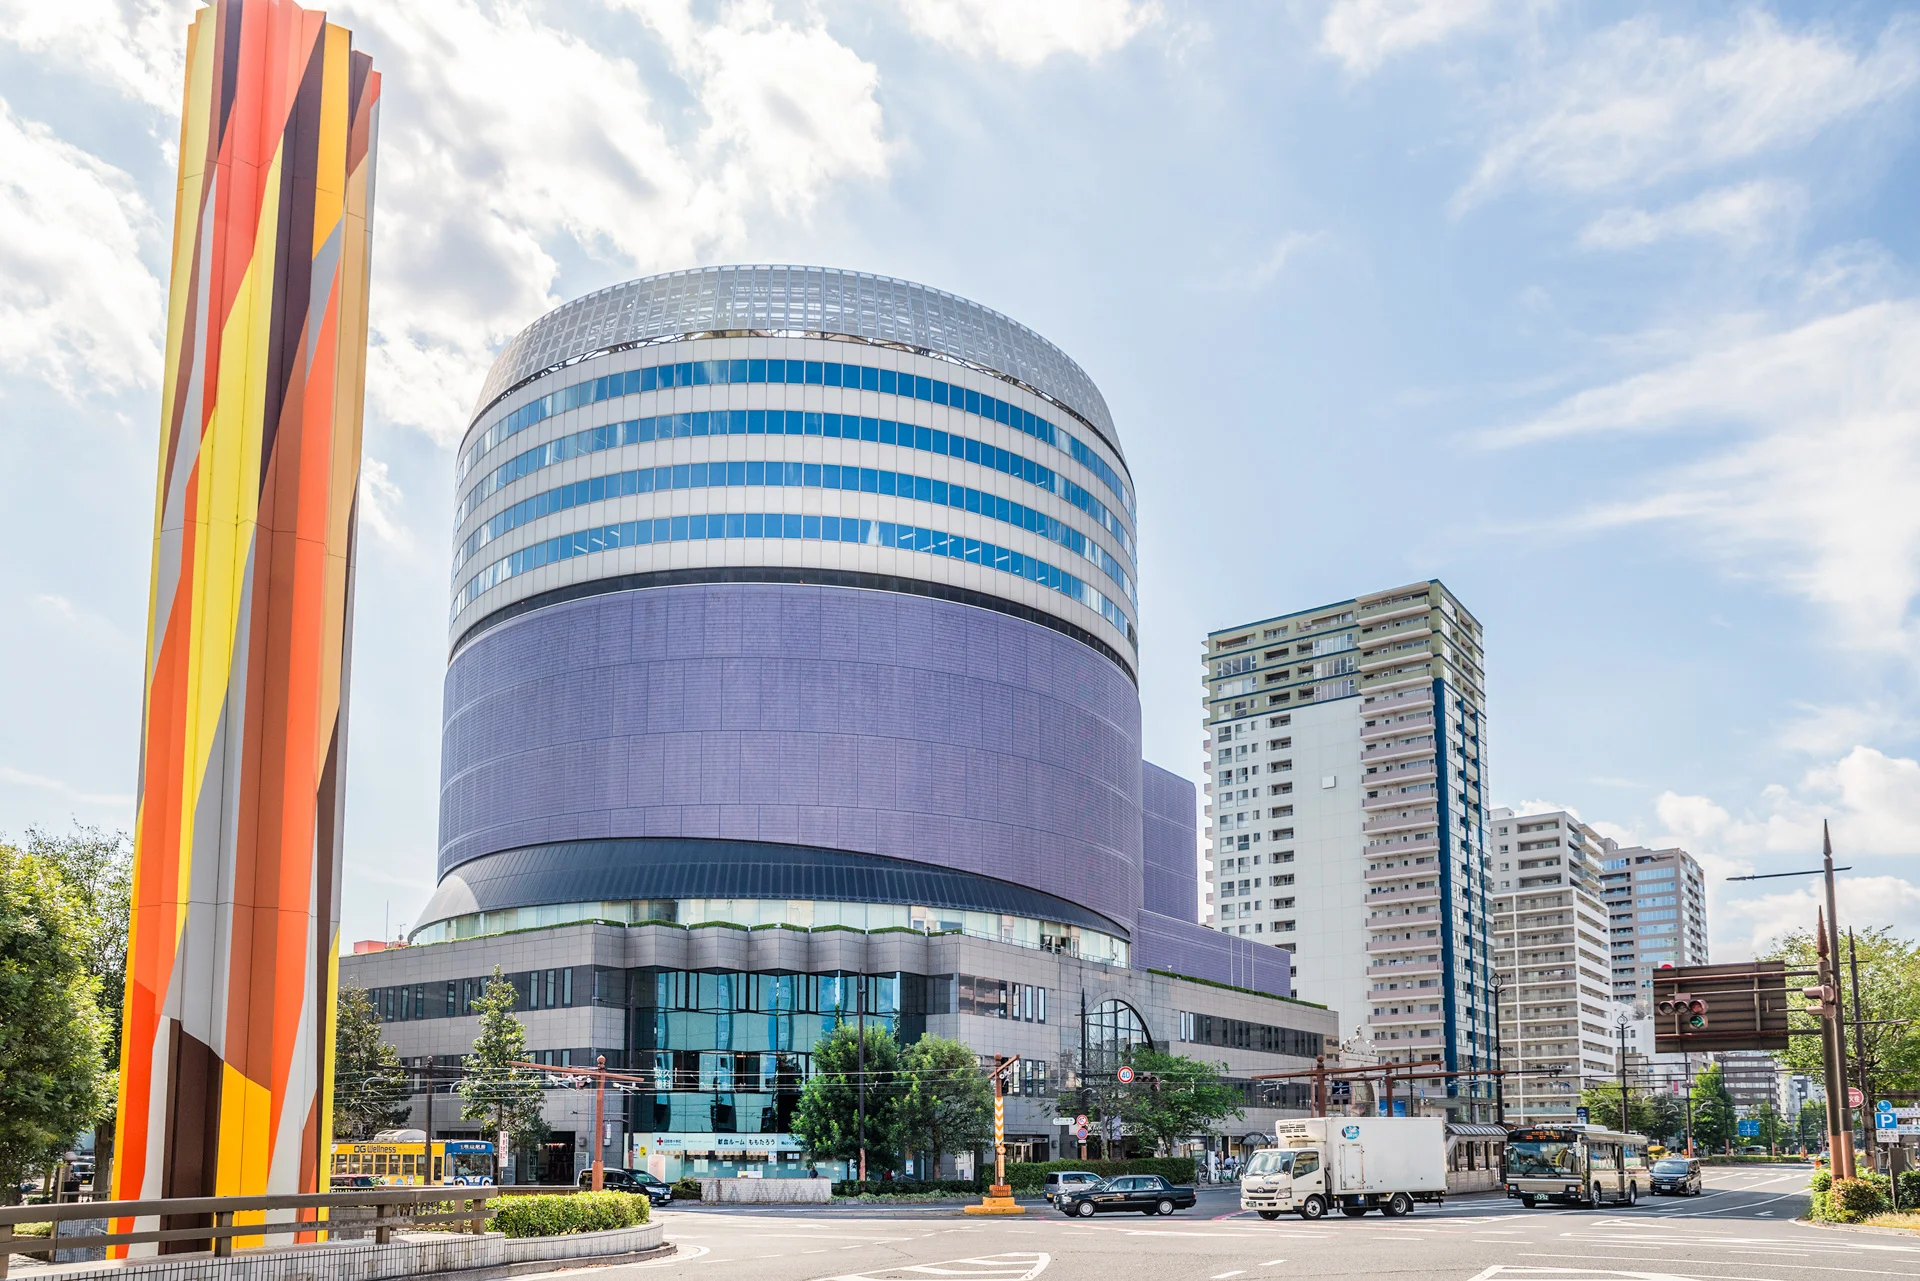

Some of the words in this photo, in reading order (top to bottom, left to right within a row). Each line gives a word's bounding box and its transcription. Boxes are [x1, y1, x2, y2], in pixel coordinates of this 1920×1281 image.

[1121, 1071, 1130, 1079] 40
[1848, 1095, 1861, 1103] 火栓
[1881, 1114, 1893, 1127] P
[353, 1145, 367, 1153] OG
[367, 1145, 396, 1153] Wellness
